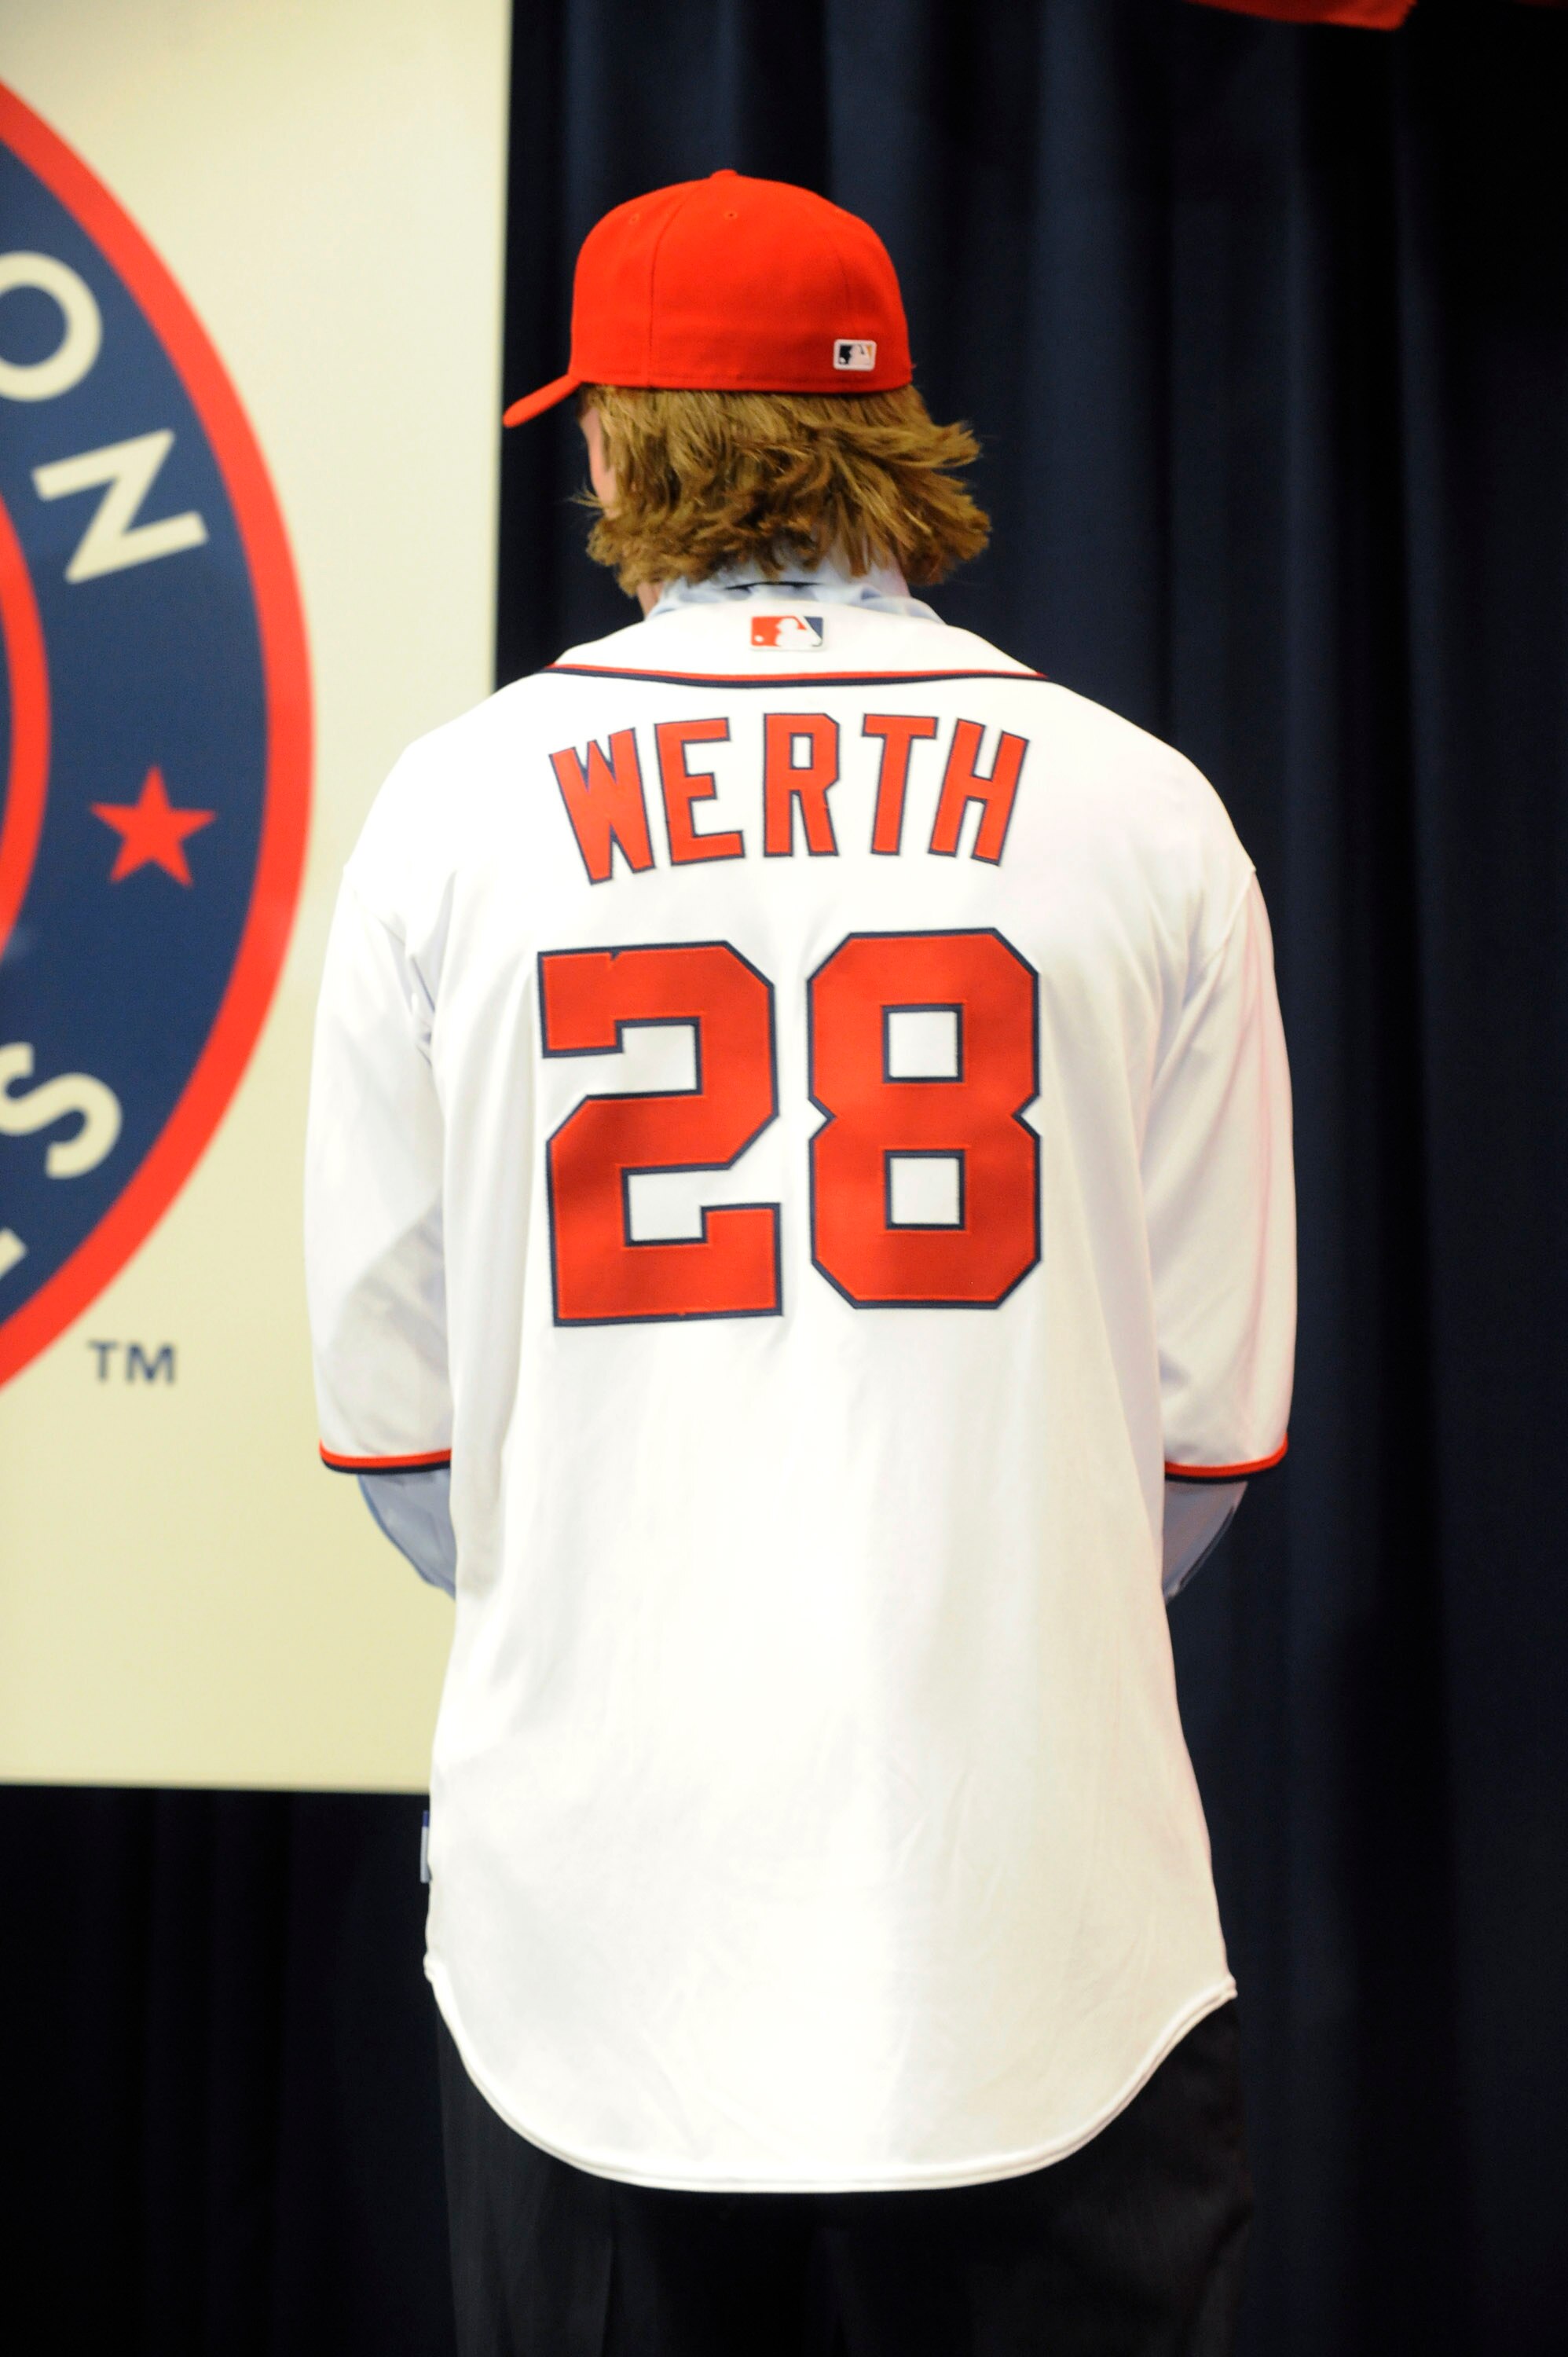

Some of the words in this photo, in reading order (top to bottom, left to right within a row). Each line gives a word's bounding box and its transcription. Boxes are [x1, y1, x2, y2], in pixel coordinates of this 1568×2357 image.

[548, 713, 1031, 885] WERTH
[537, 928, 1042, 1327] 28
[88, 1340, 178, 1384] TM
